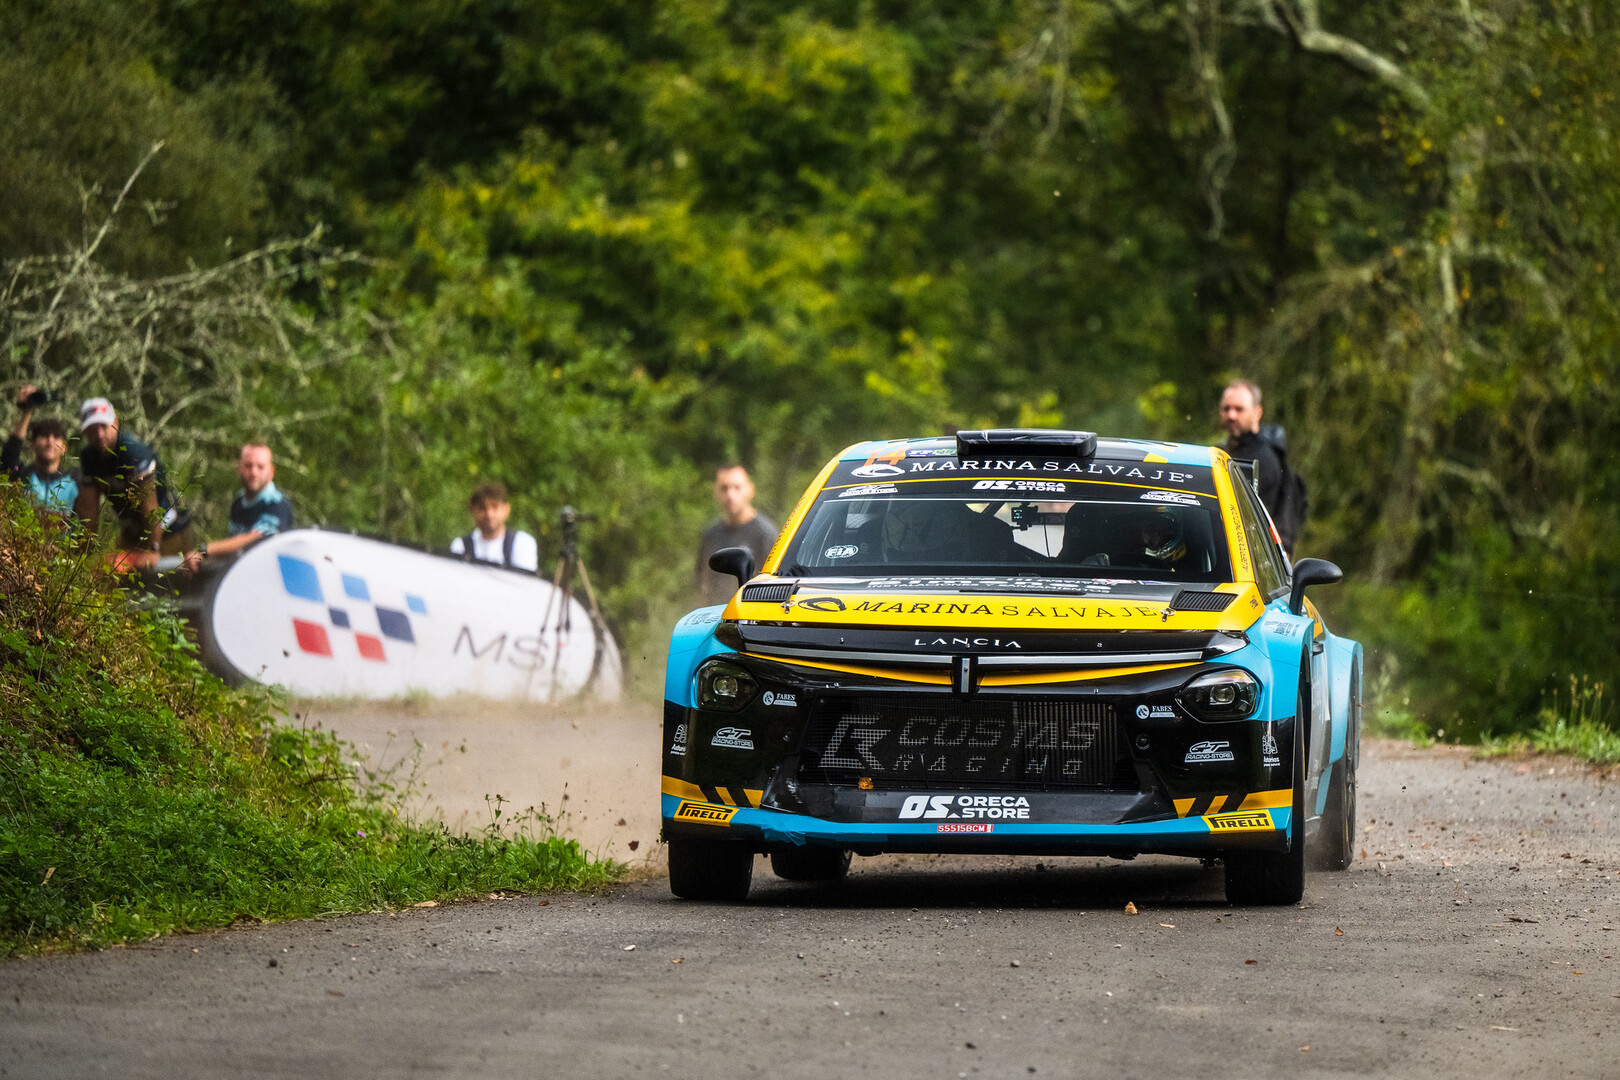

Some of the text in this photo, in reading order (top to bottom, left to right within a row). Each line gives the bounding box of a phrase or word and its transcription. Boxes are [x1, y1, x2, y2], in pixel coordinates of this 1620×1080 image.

[827, 546, 855, 558] FIA
[914, 637, 1022, 649] LANCIA
[776, 692, 796, 701] FABES
[898, 715, 1101, 750] COSTAS
[957, 796, 1030, 808] ORECA
[677, 802, 734, 821] PIRELLI
[961, 807, 1030, 819] STORE
[1207, 812, 1270, 829] PIRELLI
